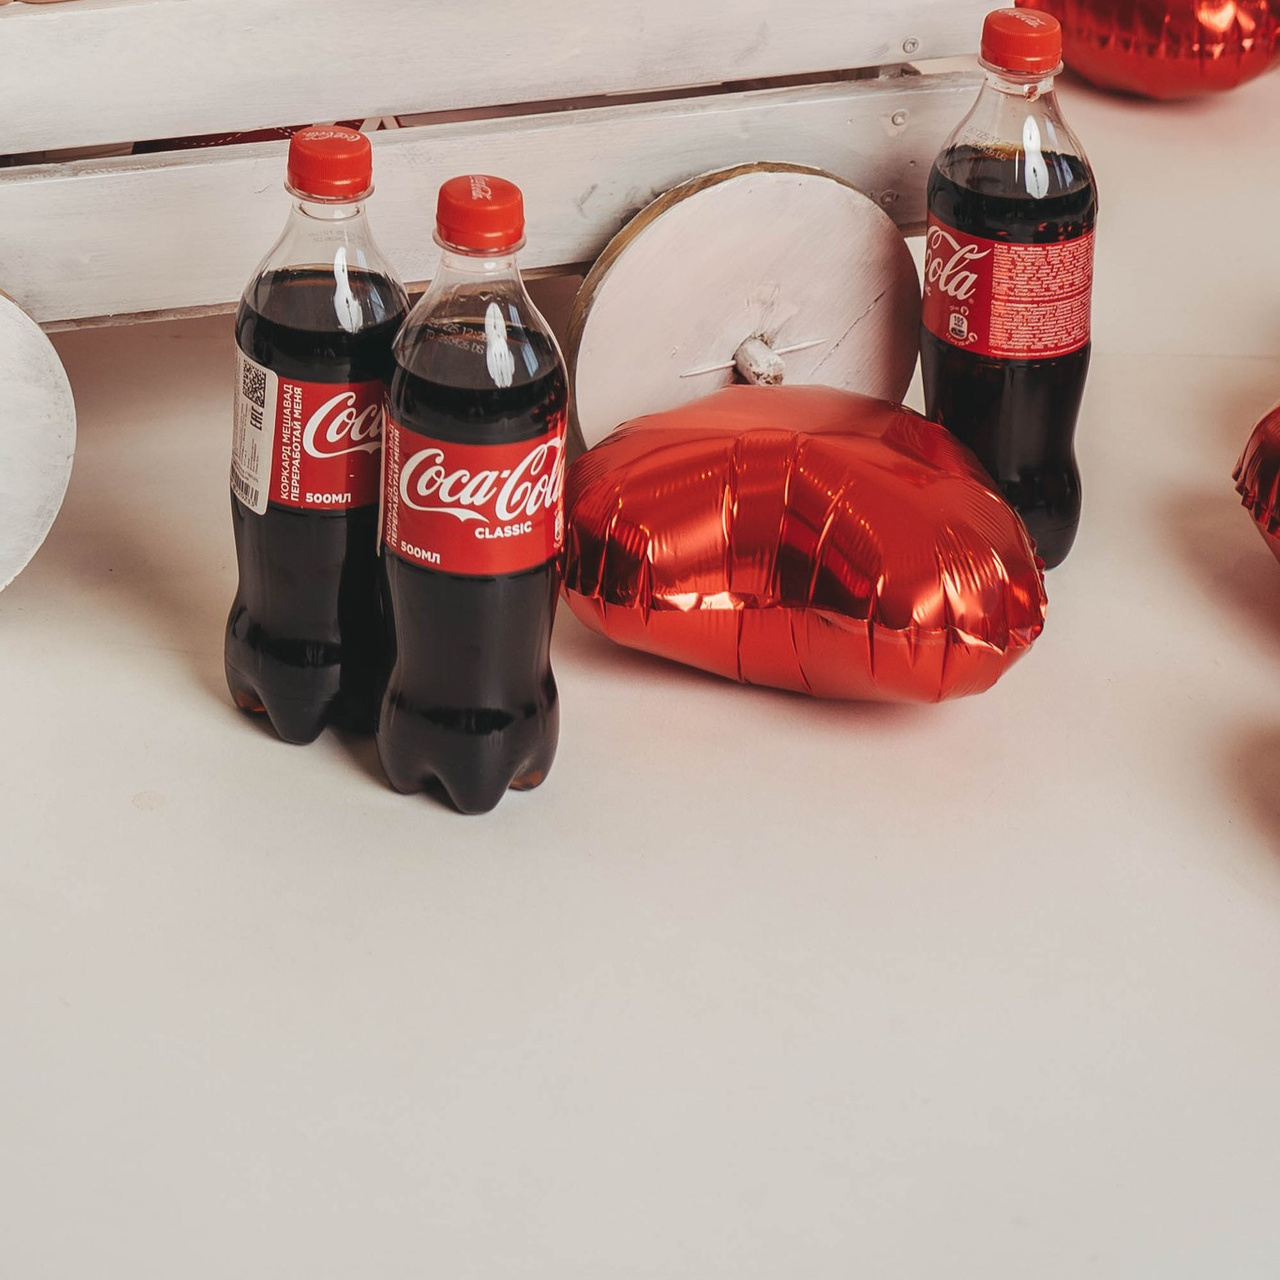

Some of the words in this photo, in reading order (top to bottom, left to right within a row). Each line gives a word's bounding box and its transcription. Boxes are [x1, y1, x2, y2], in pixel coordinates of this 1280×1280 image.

[282, 383, 294, 444] МЕШАВАД
[293, 387, 303, 419] МЕНЯ
[280, 446, 292, 500] КОРКАРД
[290, 420, 302, 502] ПЕРЕРАБОТАЙ
[305, 492, 352, 504] 500МЛ
[474, 521, 532, 540] CLASSIC
[400, 540, 441, 564] 500МЛ
